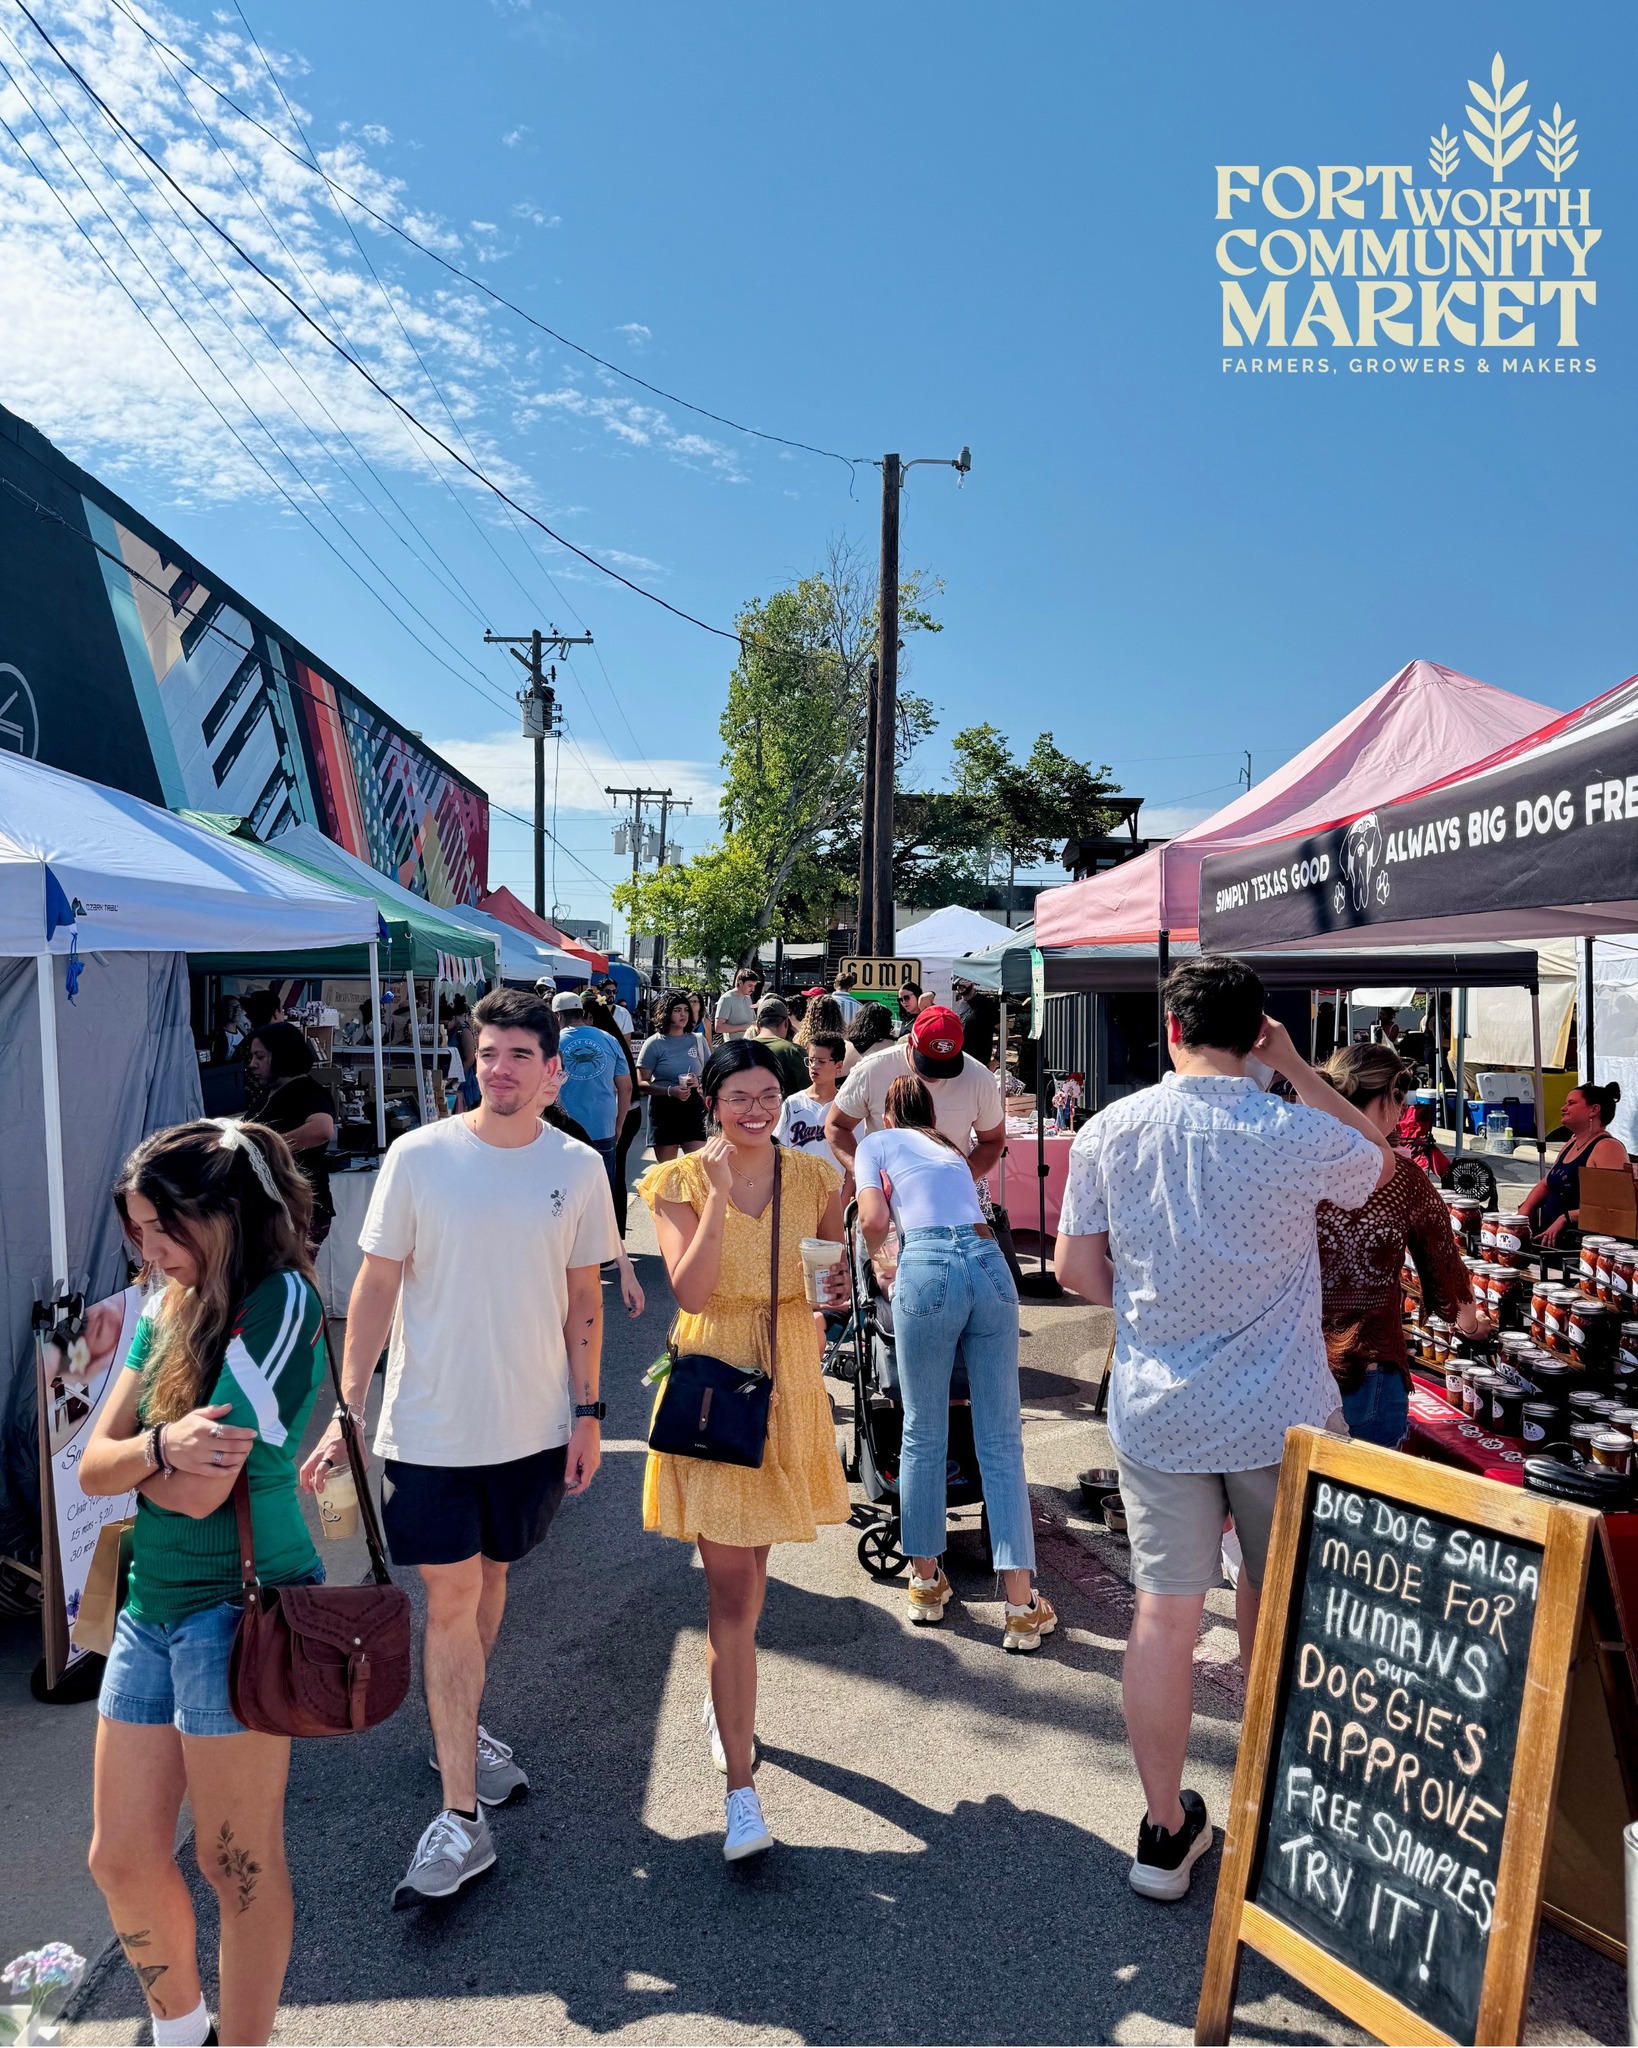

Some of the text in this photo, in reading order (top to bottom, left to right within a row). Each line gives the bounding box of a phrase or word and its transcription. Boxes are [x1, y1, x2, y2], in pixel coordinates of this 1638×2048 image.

[1215, 881, 1249, 914] SIMPLY
[1251, 868, 1288, 901] TEXAS
[1290, 854, 1330, 890] GOOD
[1385, 816, 1460, 865] ALWAYS
[1467, 806, 1506, 848] BIG
[1515, 790, 1574, 838] DOG
[1313, 1482, 1364, 1524] BIG
[1370, 1498, 1436, 1550] DOG
[1322, 1538, 1516, 1655] MADE FOR
[1325, 1587, 1489, 1699] HUMANS
[1299, 1643, 1487, 1776] DOGGIE'S
[1307, 1710, 1503, 1853] APPROVE
[1280, 1834, 1439, 1981] TRY IT!
[1287, 1766, 1497, 1933] FREE SAMPLES
